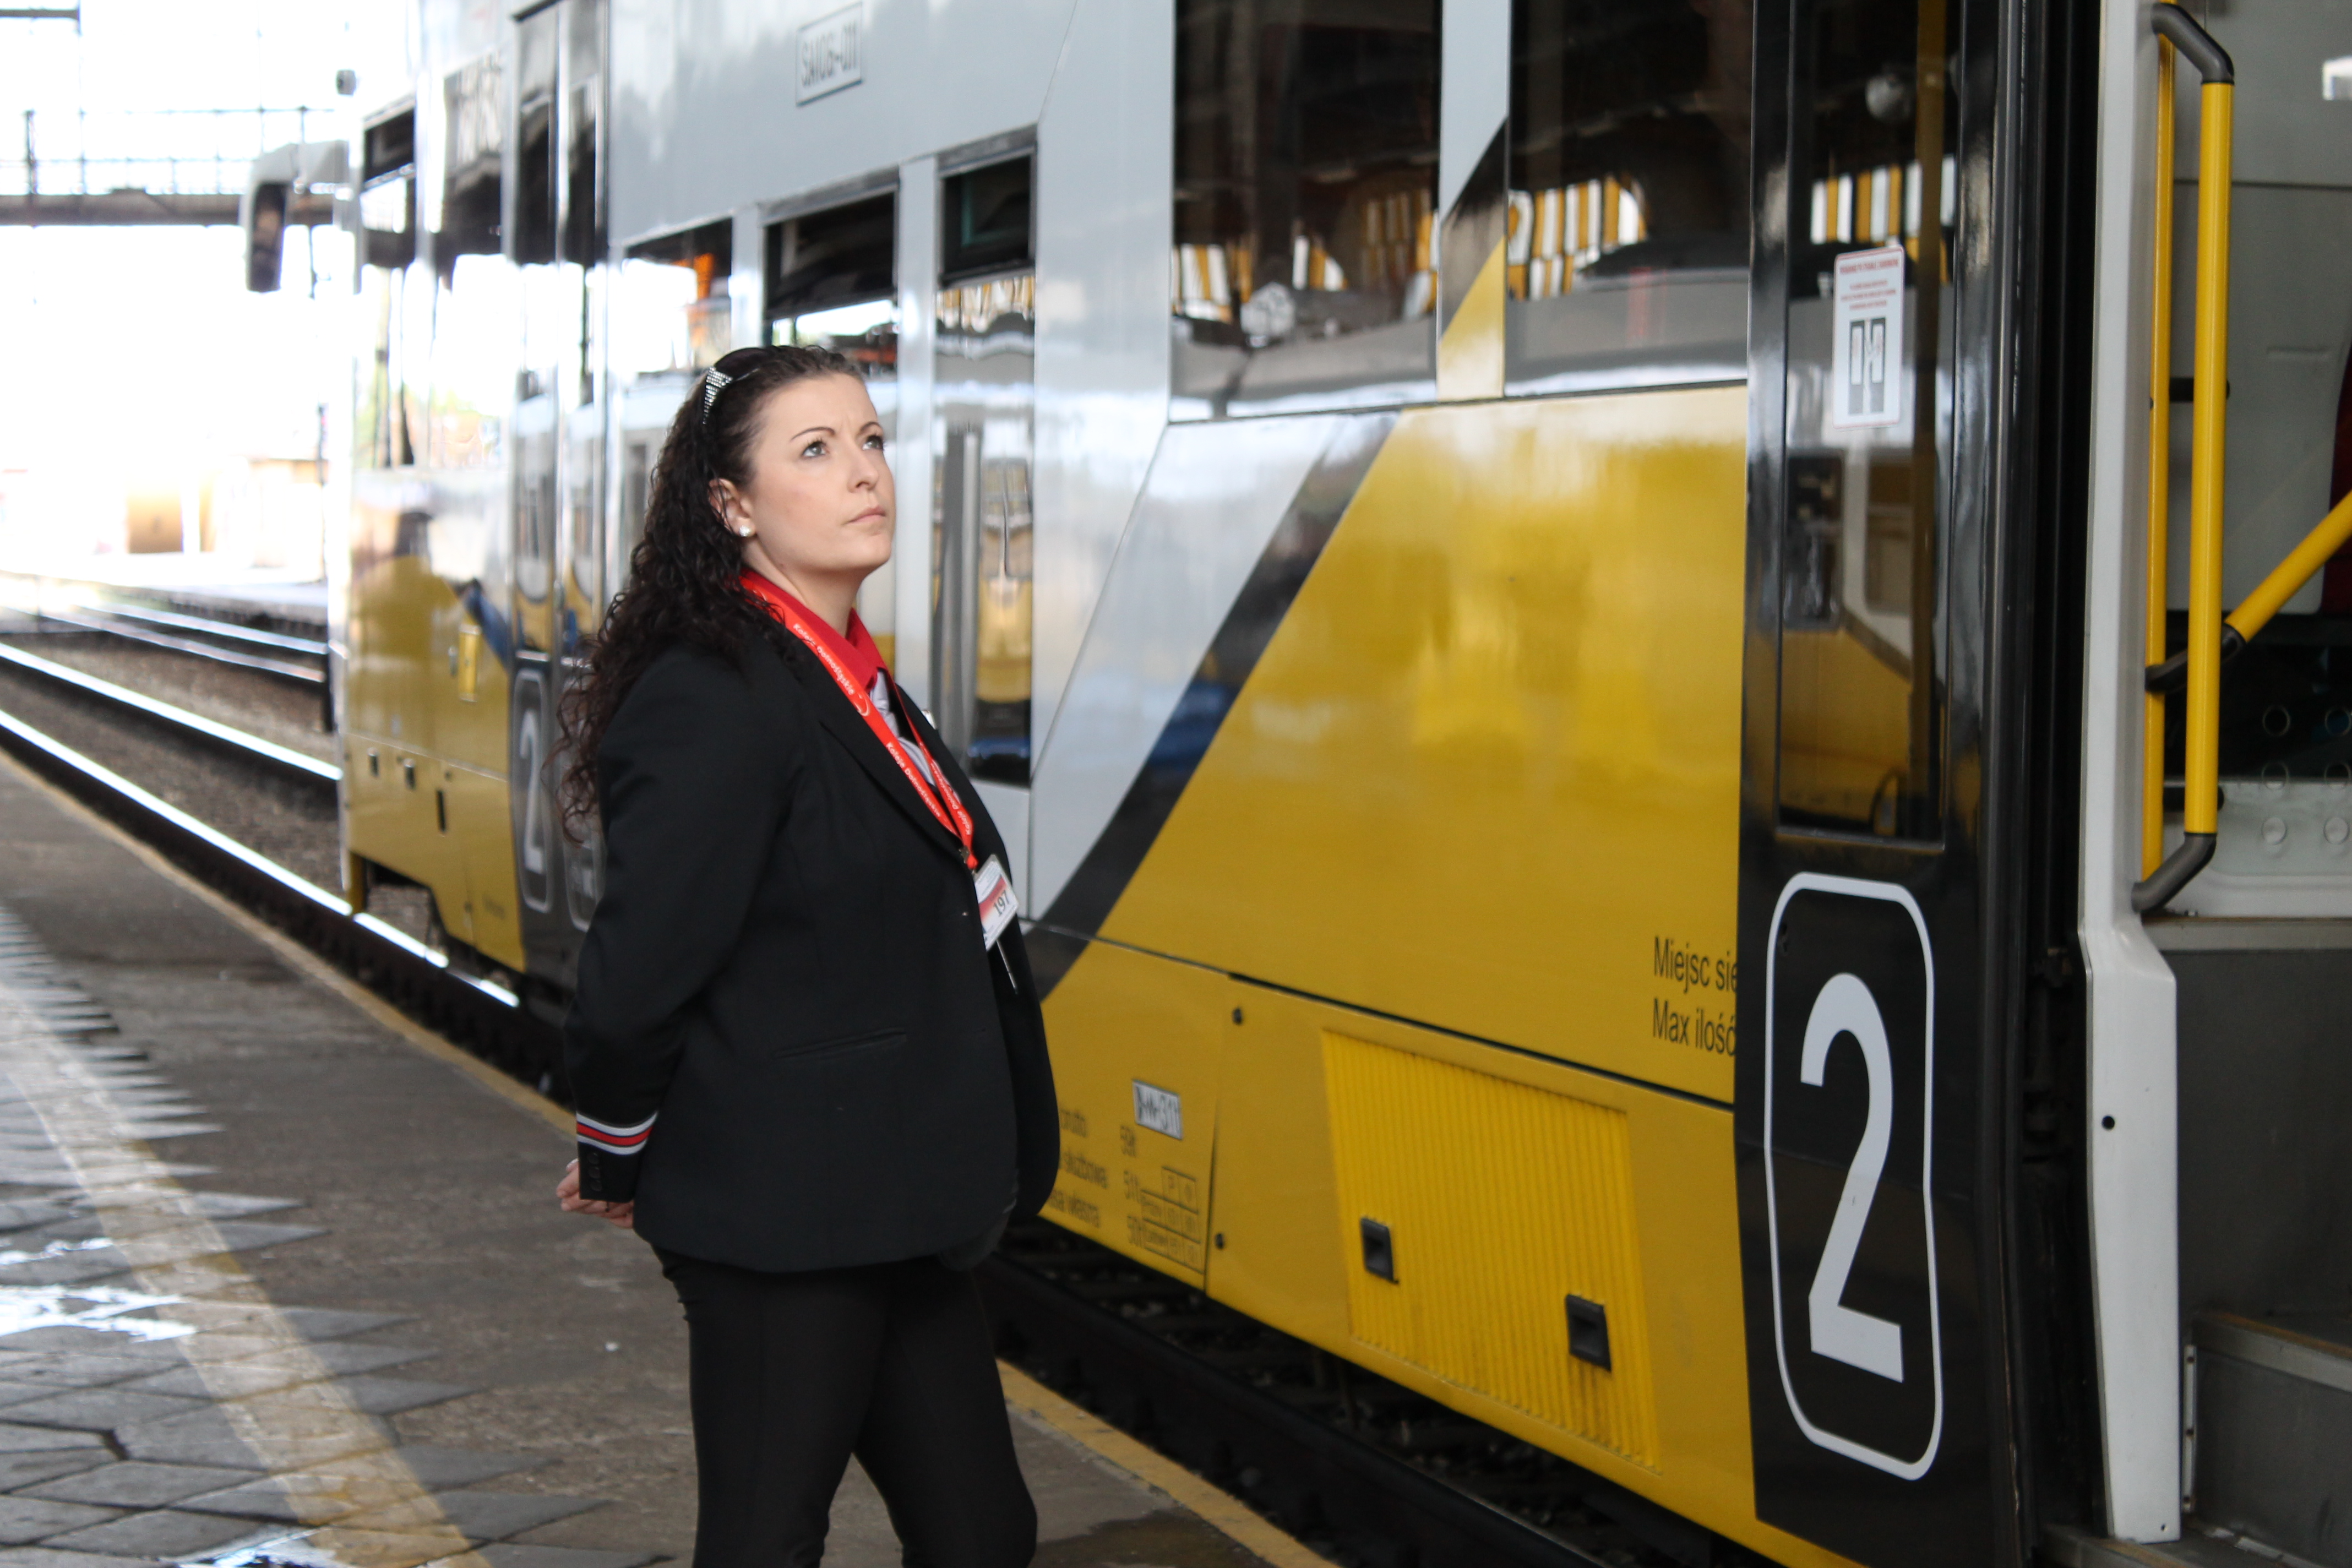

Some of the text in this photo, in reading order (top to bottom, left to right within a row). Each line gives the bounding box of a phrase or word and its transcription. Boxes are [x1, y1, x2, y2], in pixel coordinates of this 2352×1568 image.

[519, 708, 544, 875] 2
[993, 890, 1010, 917] 197
[1653, 935, 1710, 994] Miejsc
[1653, 997, 1690, 1047] Max
[1800, 972, 1903, 1383] 2
